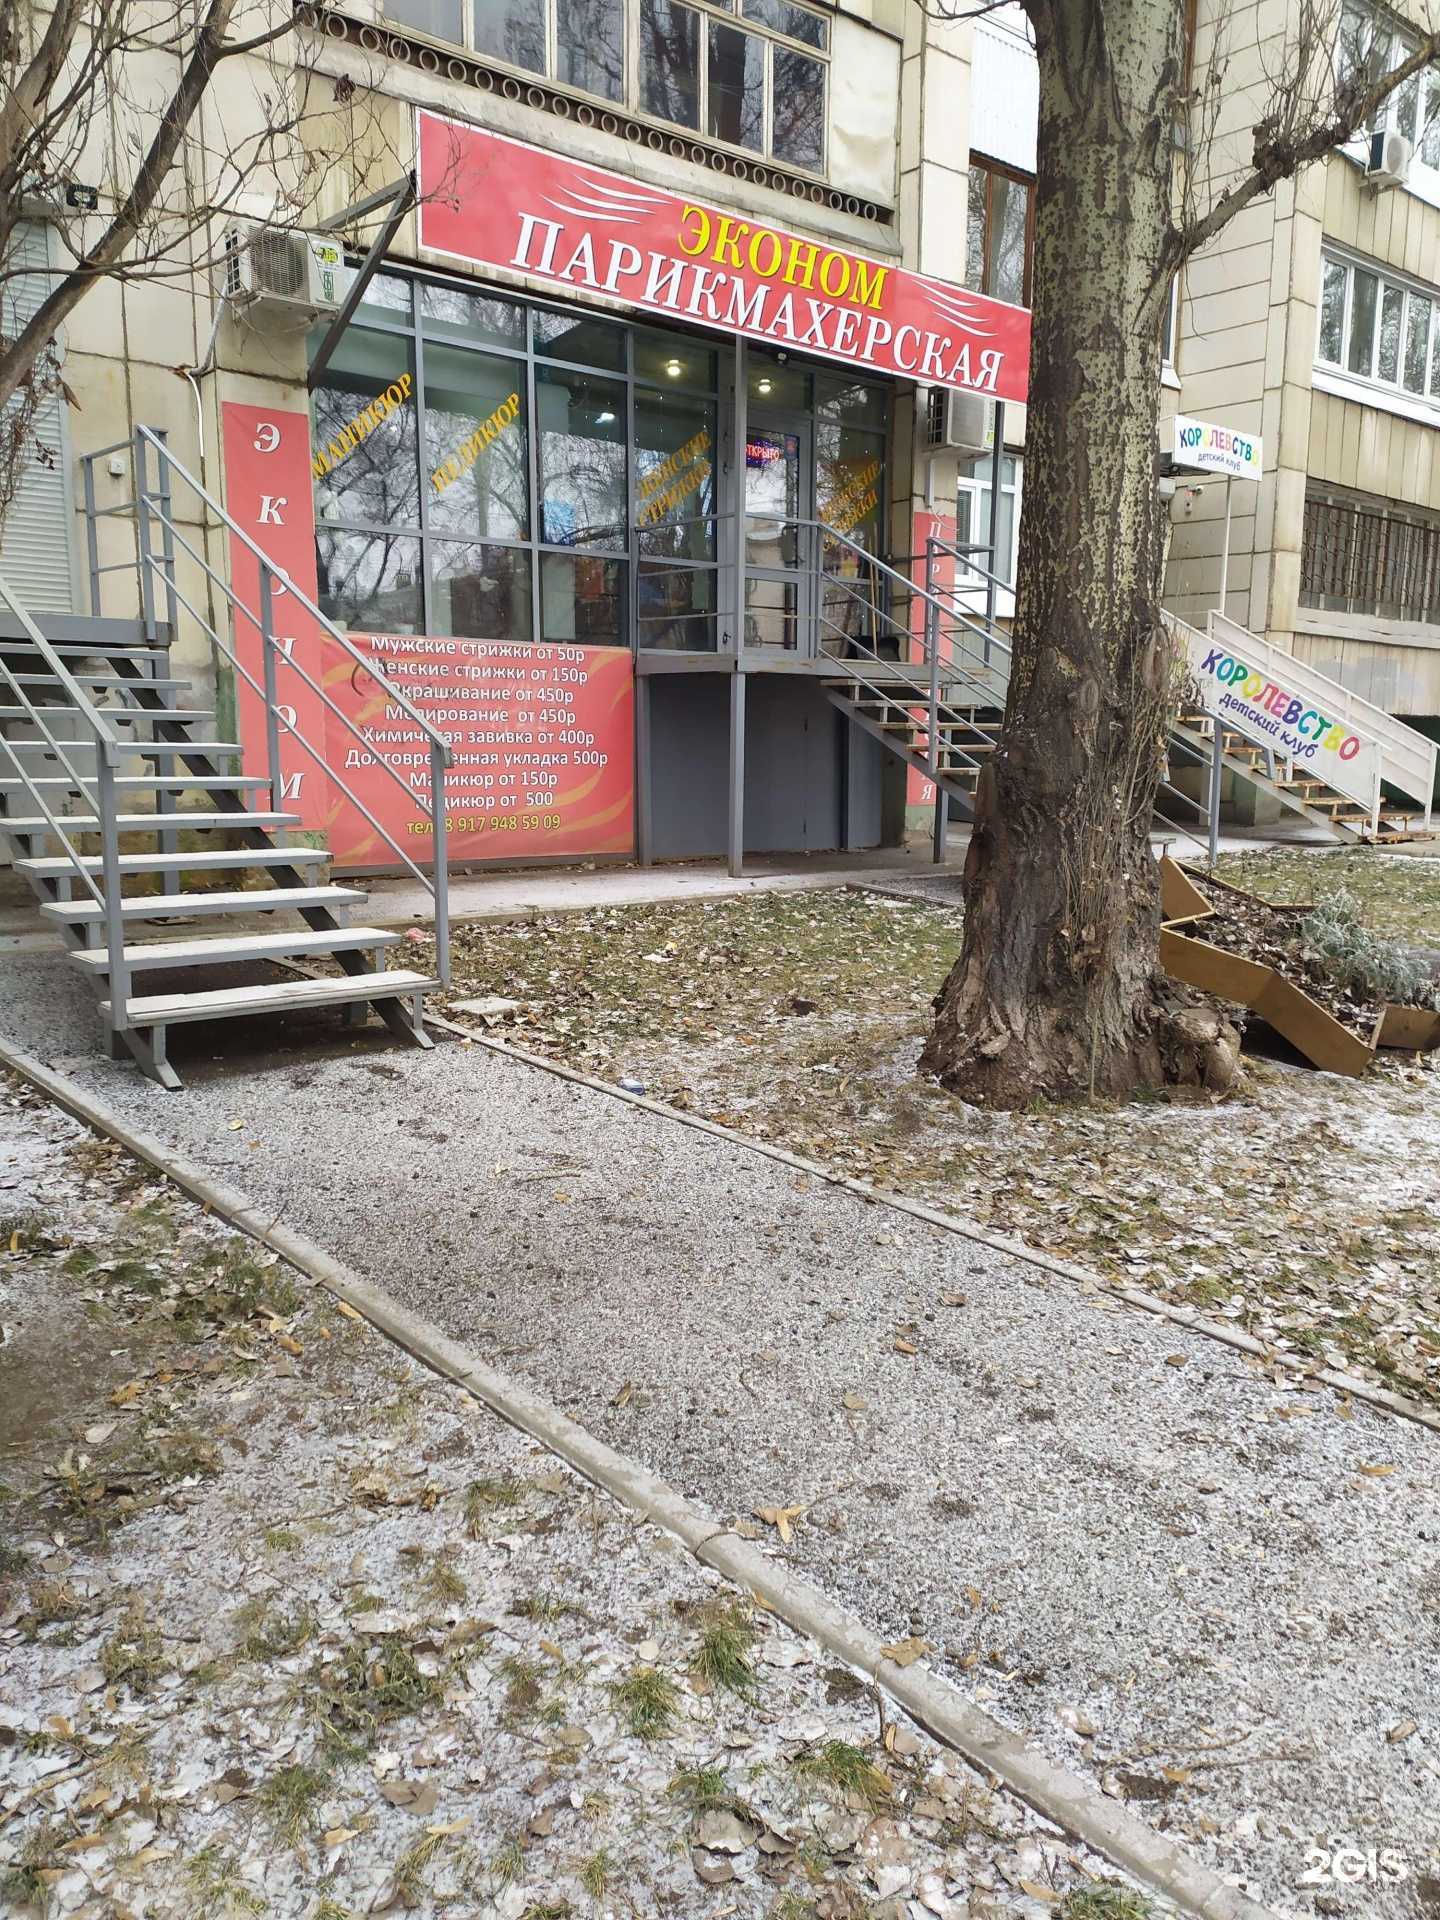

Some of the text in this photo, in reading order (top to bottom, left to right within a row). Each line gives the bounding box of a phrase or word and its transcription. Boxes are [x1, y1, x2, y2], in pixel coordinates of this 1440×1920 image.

[677, 203, 889, 311] ЭКОНОМ
[510, 212, 1005, 392] ПАРИКМАХЕРСКАЯ
[313, 372, 412, 480] МАНИКЮР
[745, 443, 780, 461] ТКРЫТО
[1180, 427, 1258, 465] КОРОЛЕВСТВО
[371, 636, 585, 664] Мужские стрижки от 50р
[455, 665, 526, 681] стрижки
[531, 669, 547, 682] от
[552, 667, 588, 686] 150р
[515, 689, 533, 701] от
[537, 687, 574, 706] 450р
[1200, 649, 1360, 761] КОРОЛЕВСТВО
[518, 710, 536, 722] от
[539, 708, 576, 727] 450р
[1218, 692, 1319, 758] детский клуб
[363, 726, 595, 747] Химичеая завивка от 400р
[345, 749, 608, 768] Договреенная укладка 500р
[499, 774, 516, 786] от
[521, 771, 558, 788] 150р
[500, 794, 517, 807] от
[526, 792, 553, 807] 500
[445, 817, 453, 832] 8
[458, 817, 485, 832] 917
[490, 815, 517, 831] 948
[522, 815, 539, 830] 59
[543, 814, 561, 829] 09
